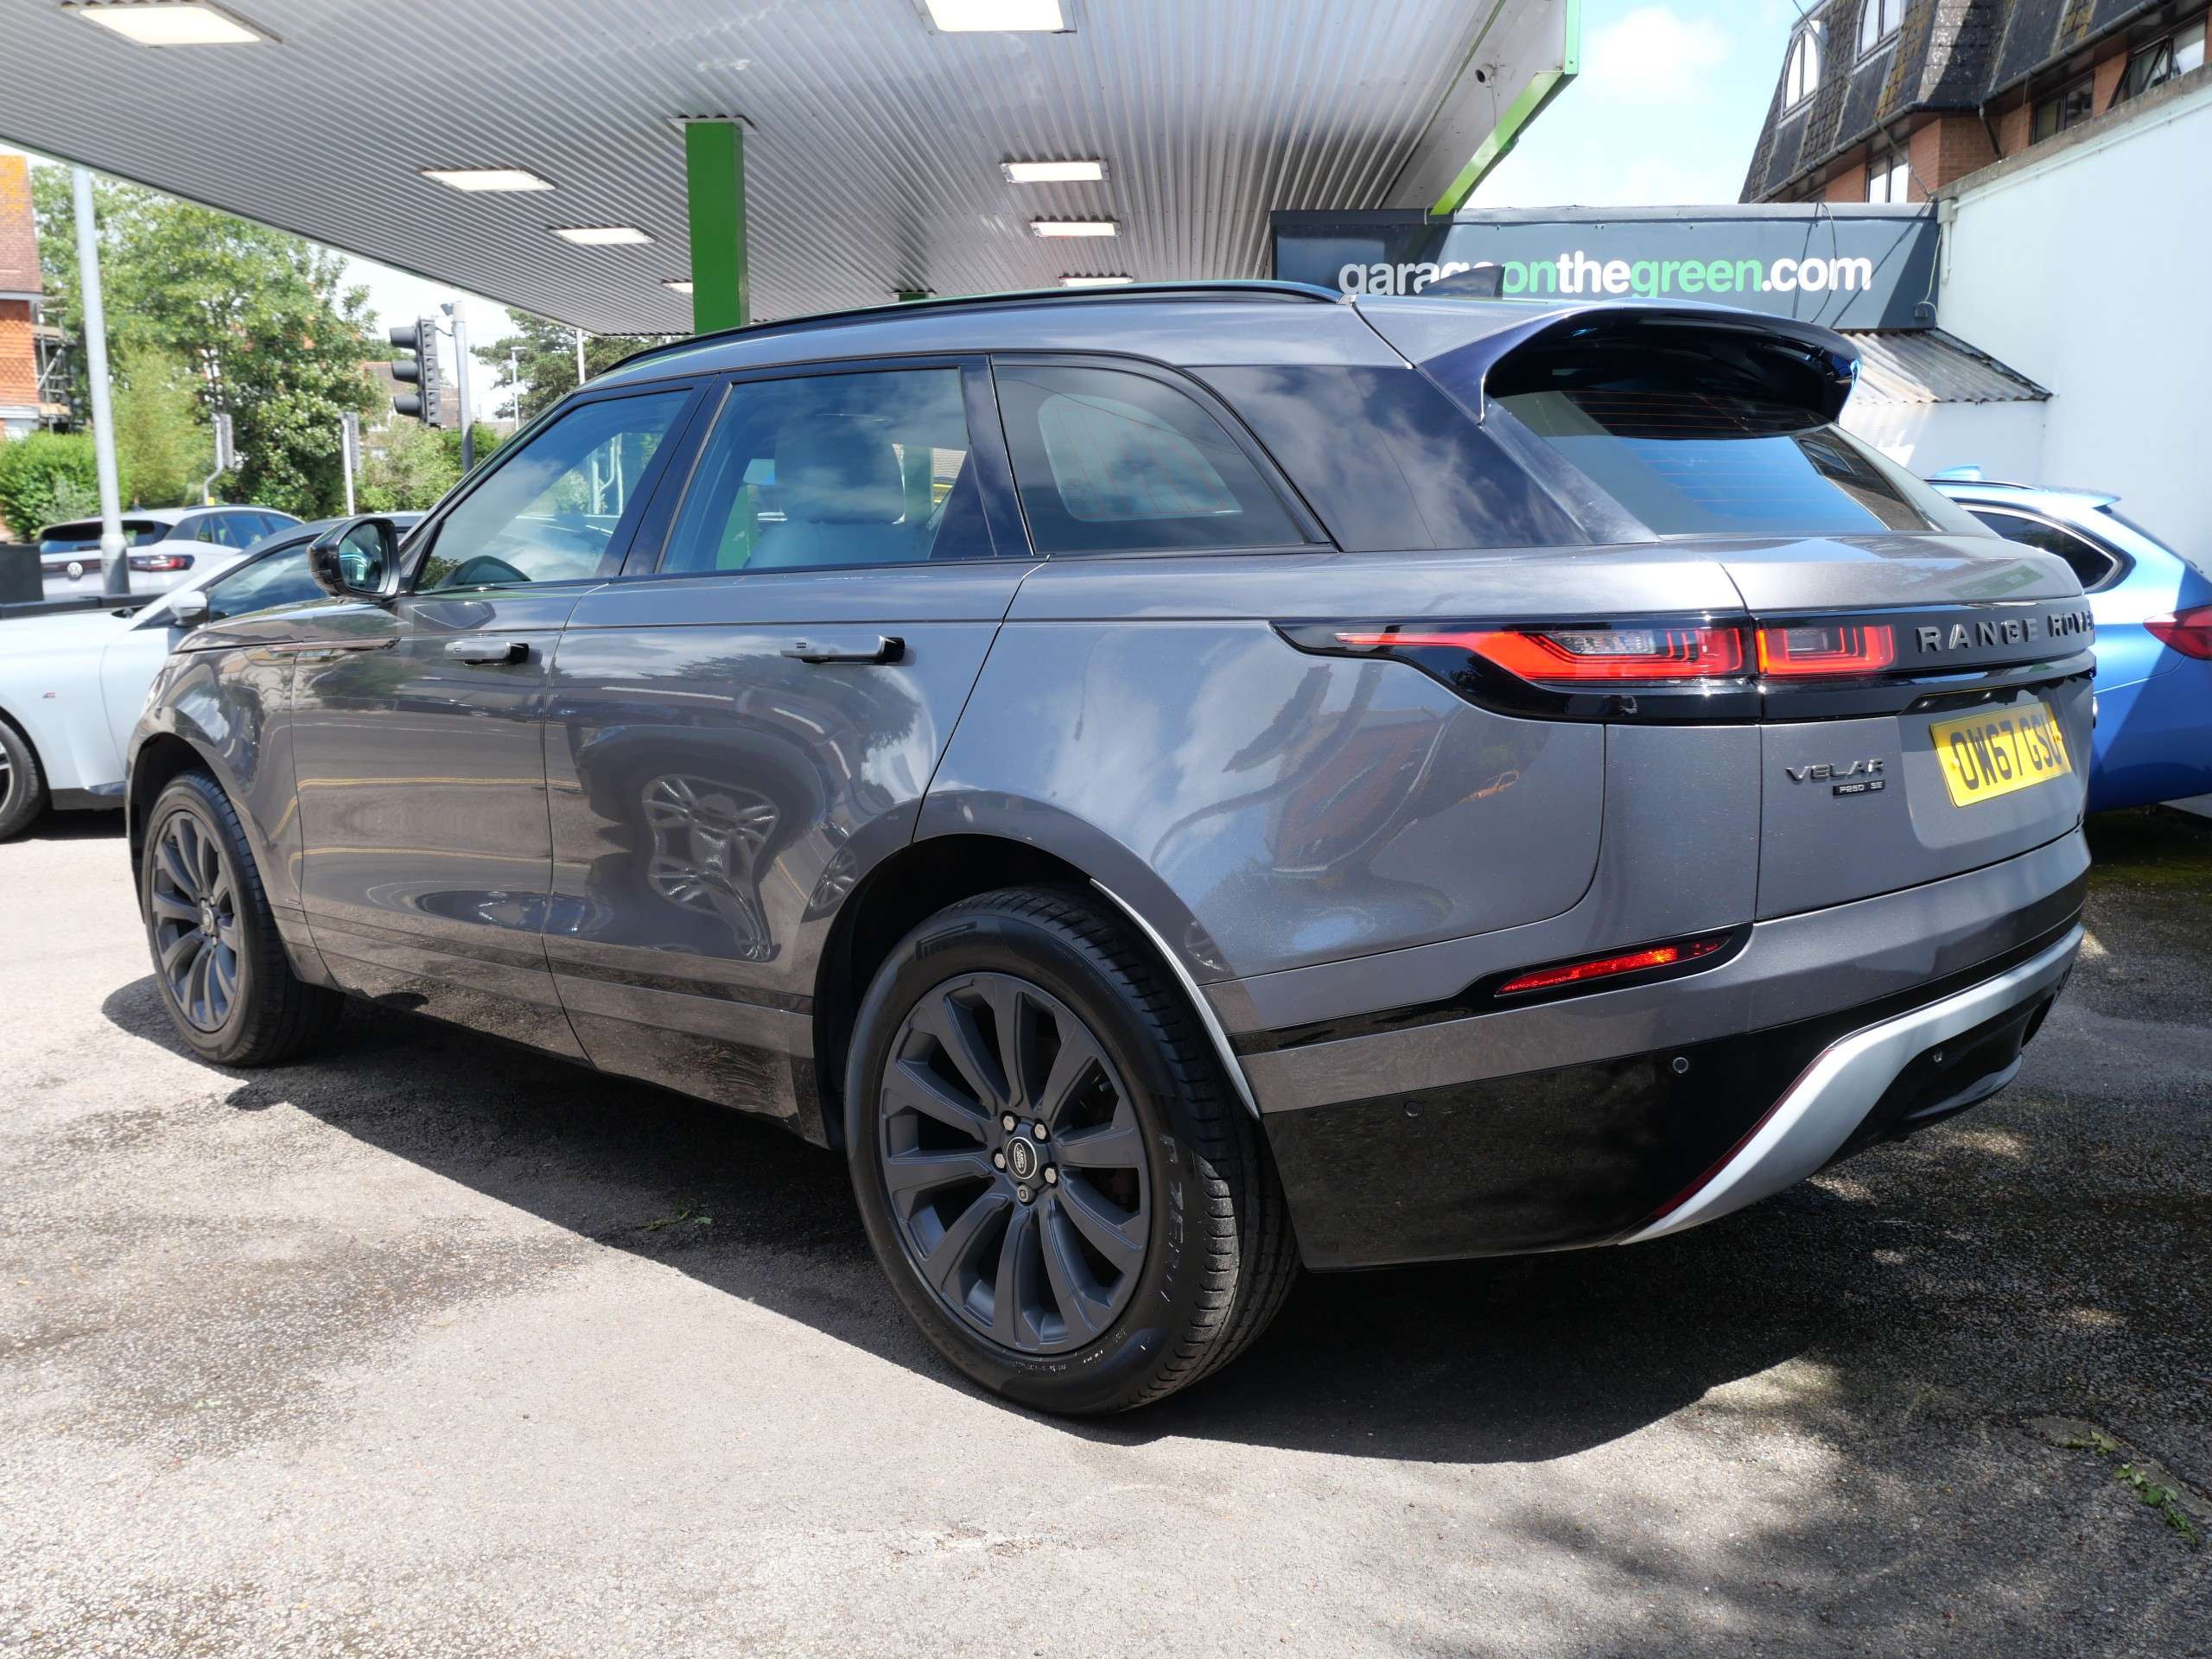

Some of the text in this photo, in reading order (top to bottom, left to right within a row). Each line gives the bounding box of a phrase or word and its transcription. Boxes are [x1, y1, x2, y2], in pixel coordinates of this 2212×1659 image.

[1338, 251, 1872, 299] garaonthegreen.com
[1915, 618, 2039, 653] RANGE
[1950, 713, 2063, 791] OW67 GSU
[1783, 759, 1884, 781] VELAR
[1839, 784, 1865, 793] P250
